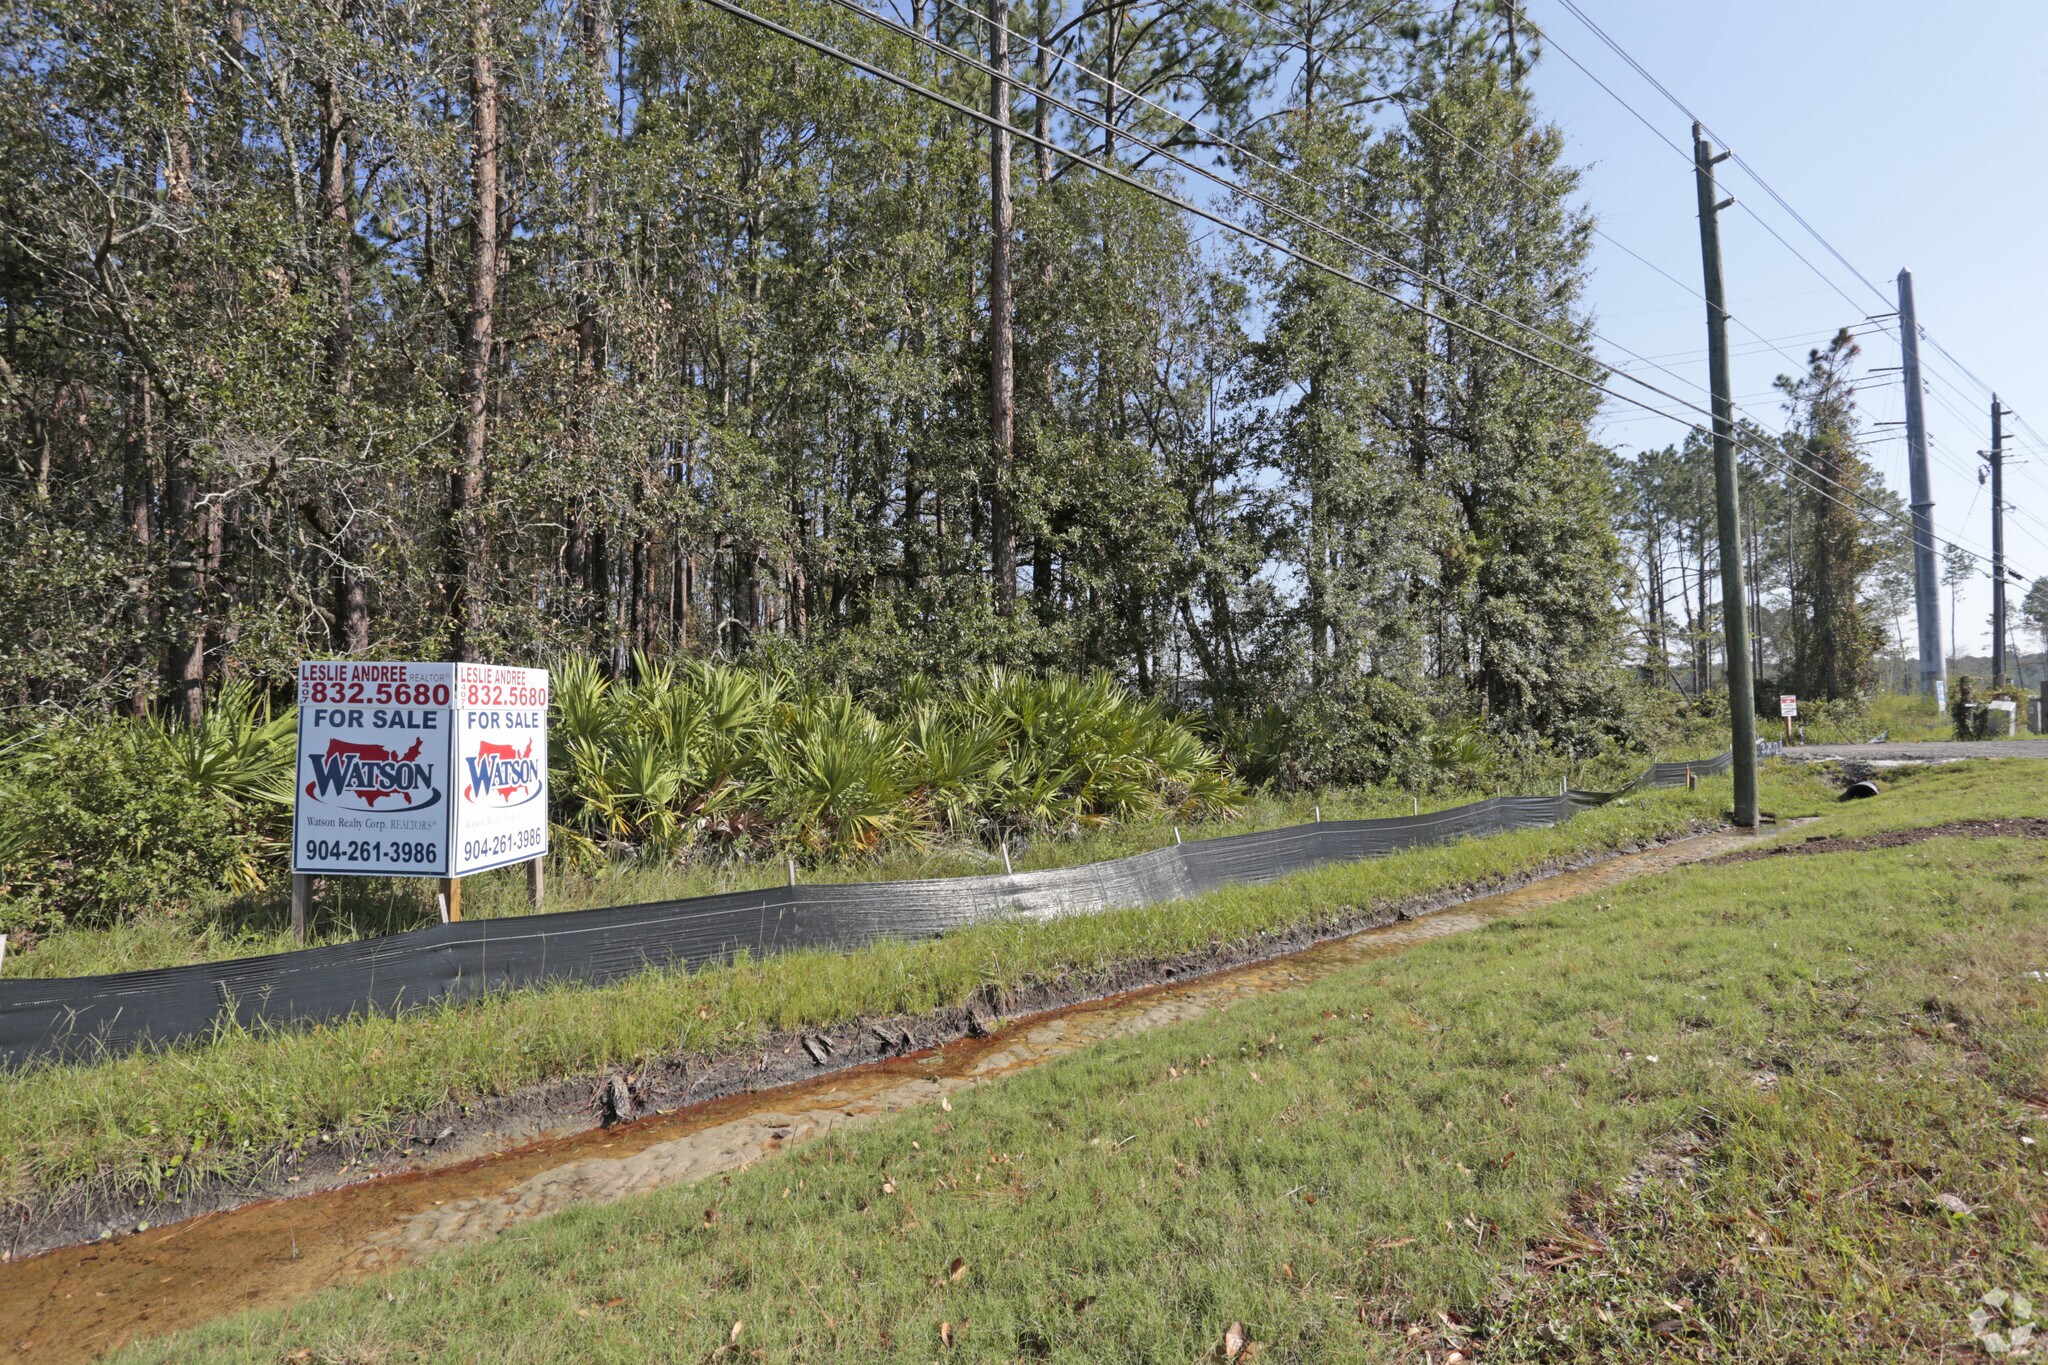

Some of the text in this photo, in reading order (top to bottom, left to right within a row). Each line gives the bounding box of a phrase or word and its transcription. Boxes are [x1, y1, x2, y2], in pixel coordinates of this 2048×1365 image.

[302, 665, 347, 682] LESLIE
[351, 666, 407, 683] ANDREE
[461, 667, 526, 686] LESLIE ANDREE
[311, 682, 450, 705] 832.5680
[467, 684, 546, 706] 832.5680
[314, 709, 438, 729] FOR SALE
[468, 711, 539, 729] FOR SALE
[308, 753, 434, 798] WATSON
[465, 755, 539, 798] WATSON
[307, 816, 336, 827] Watson
[338, 817, 362, 832] Realty
[365, 818, 388, 832] Corp.
[306, 839, 437, 864] 904-261-3986
[464, 827, 541, 861] 904-261-3986
